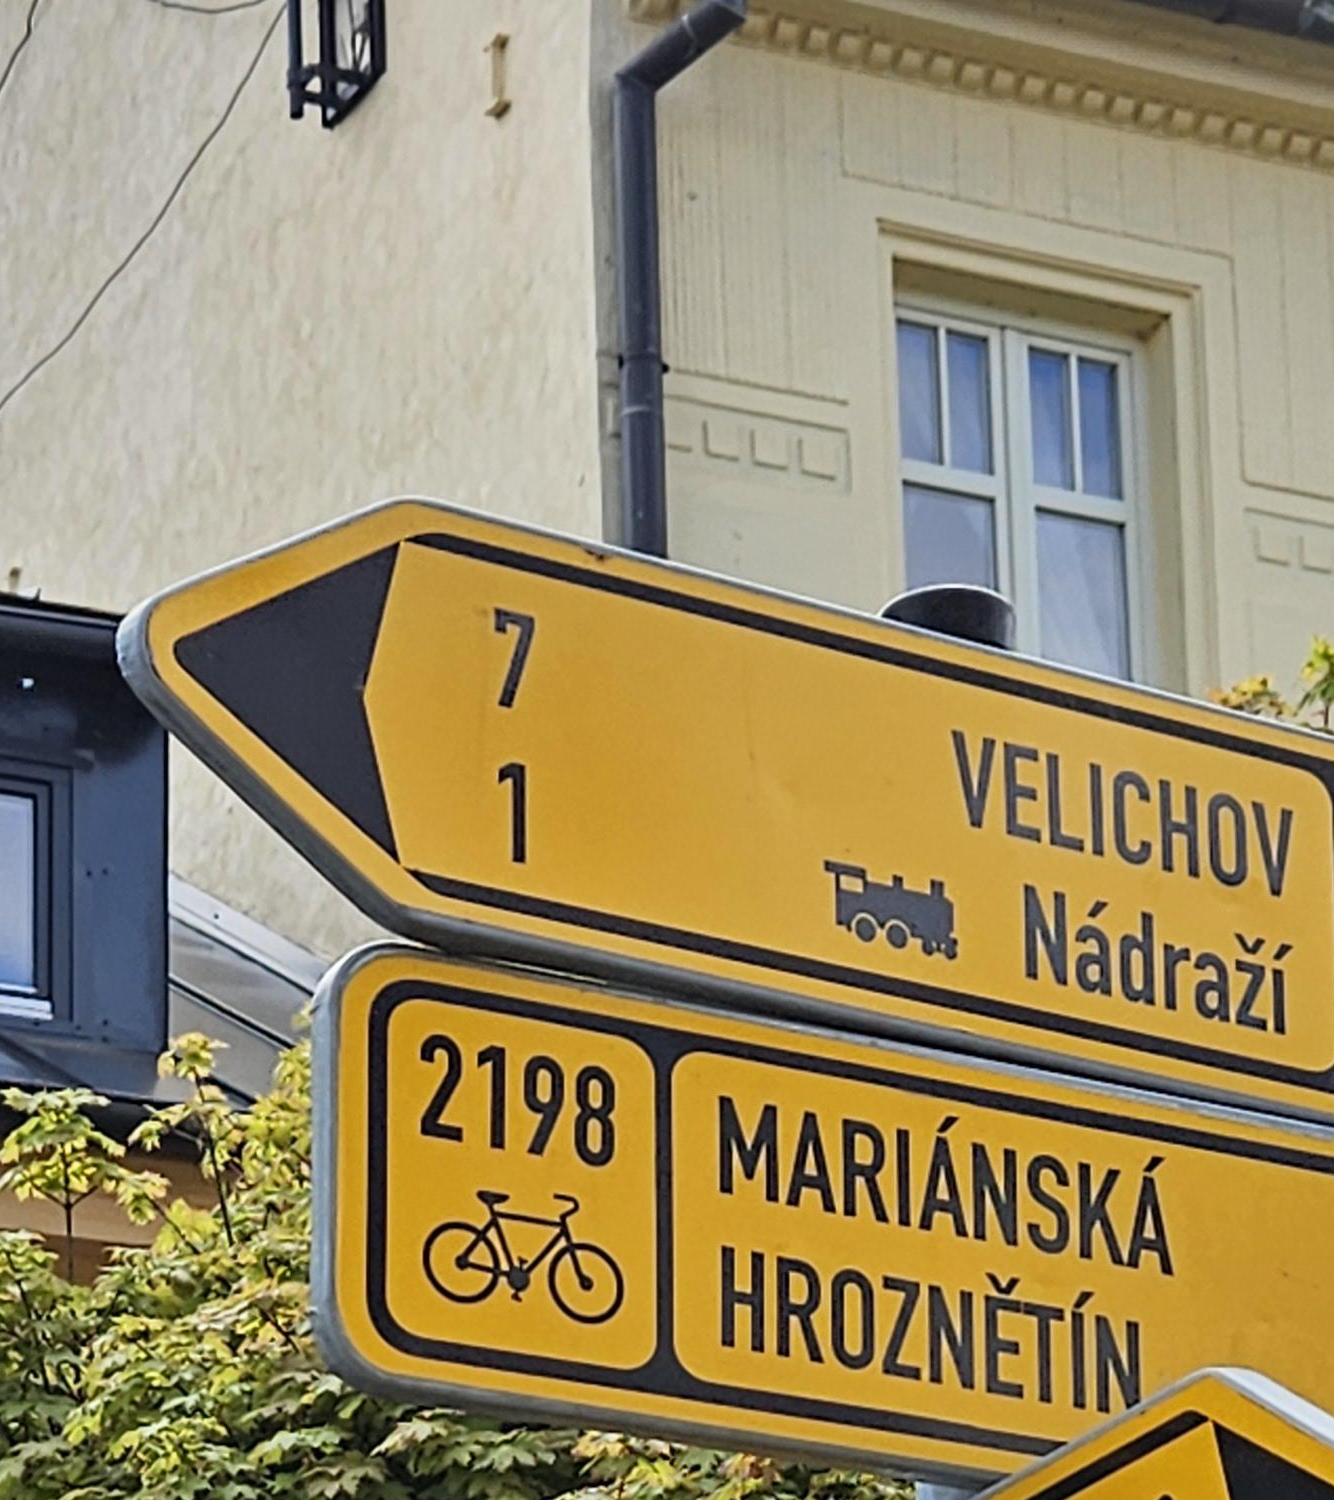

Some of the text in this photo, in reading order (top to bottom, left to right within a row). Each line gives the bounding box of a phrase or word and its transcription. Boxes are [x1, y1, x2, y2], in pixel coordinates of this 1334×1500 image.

[493, 607, 1293, 898] 7 VELICHOV
[496, 762, 1293, 1036] 1 Nádraží
[420, 1034, 616, 1168] 2198
[718, 1095, 1174, 1277] MARIÁNSKÁ
[721, 1245, 1142, 1416] HROZNĚTÍN
